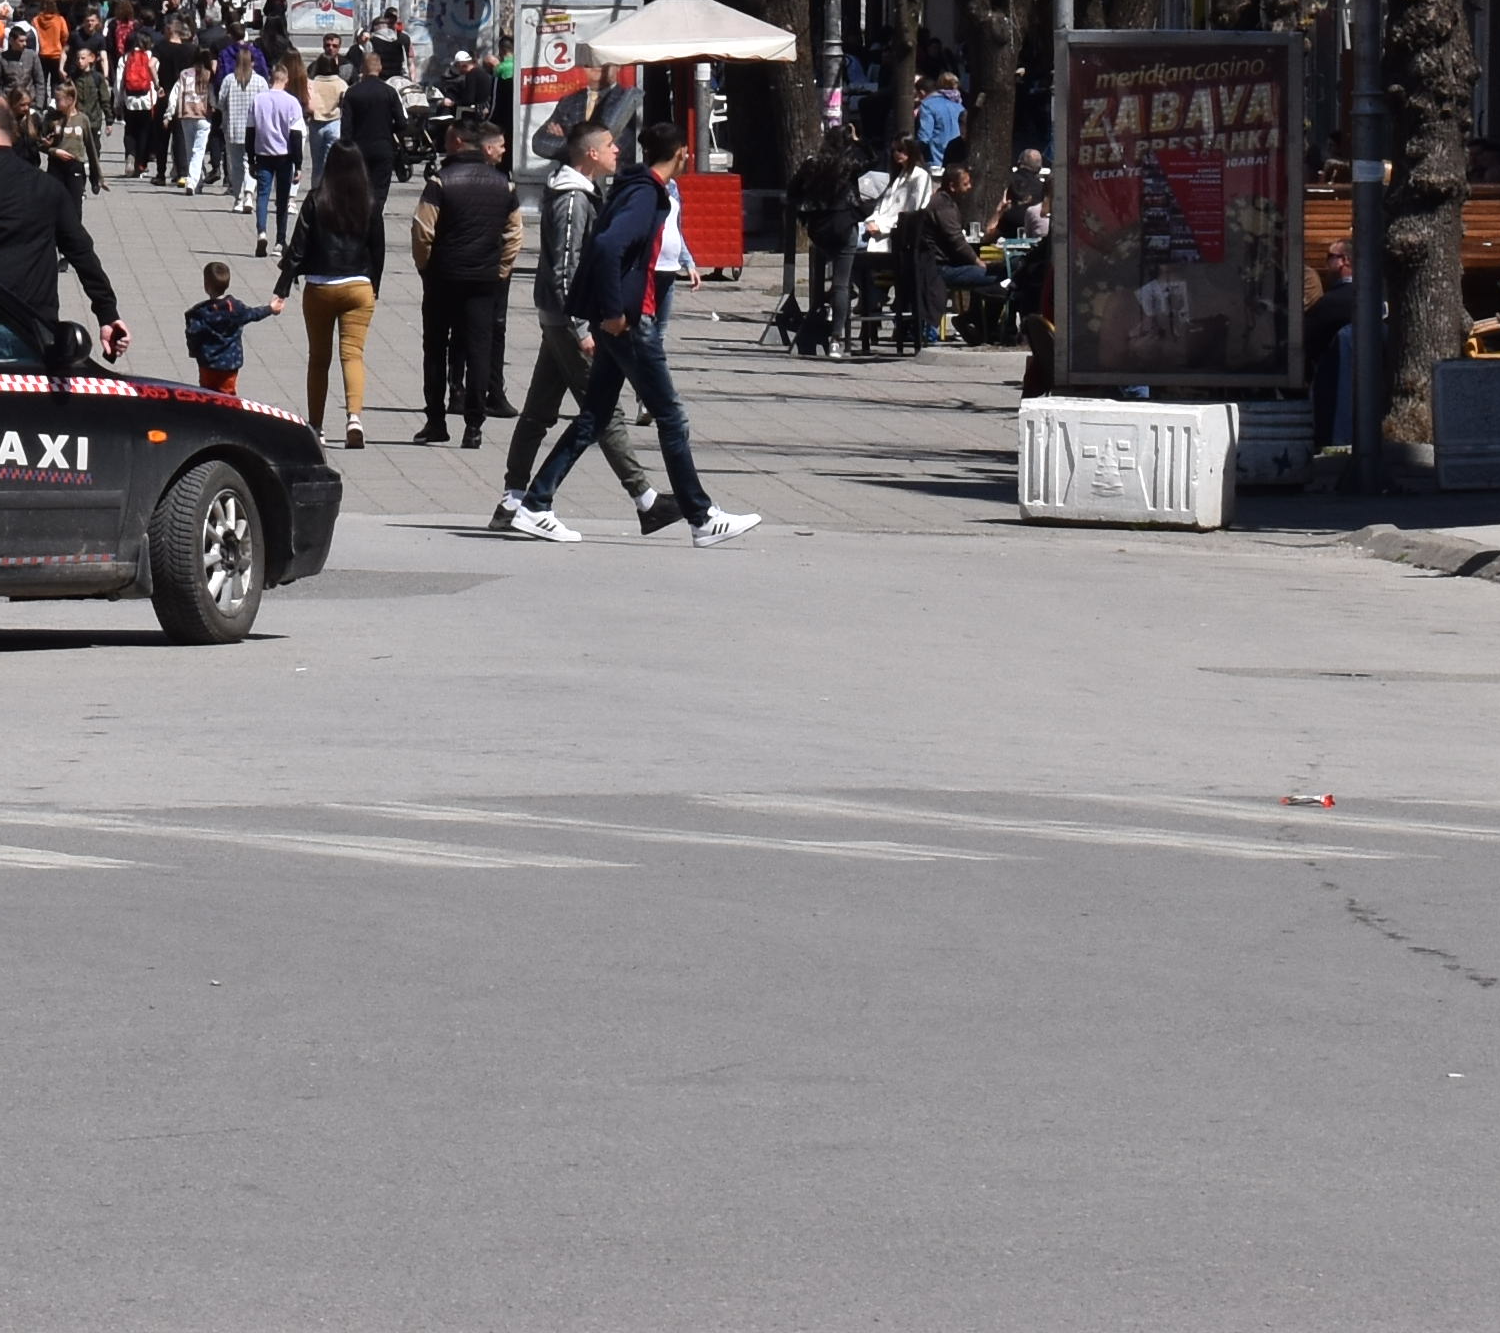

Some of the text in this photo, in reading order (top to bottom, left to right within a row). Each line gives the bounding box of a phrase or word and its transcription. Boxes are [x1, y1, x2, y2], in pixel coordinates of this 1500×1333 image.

[552, 42, 572, 65] 2.
[1095, 55, 1265, 90] meridiancasino
[1080, 83, 1278, 139] ZABAVA
[1077, 142, 1123, 166] BEZ
